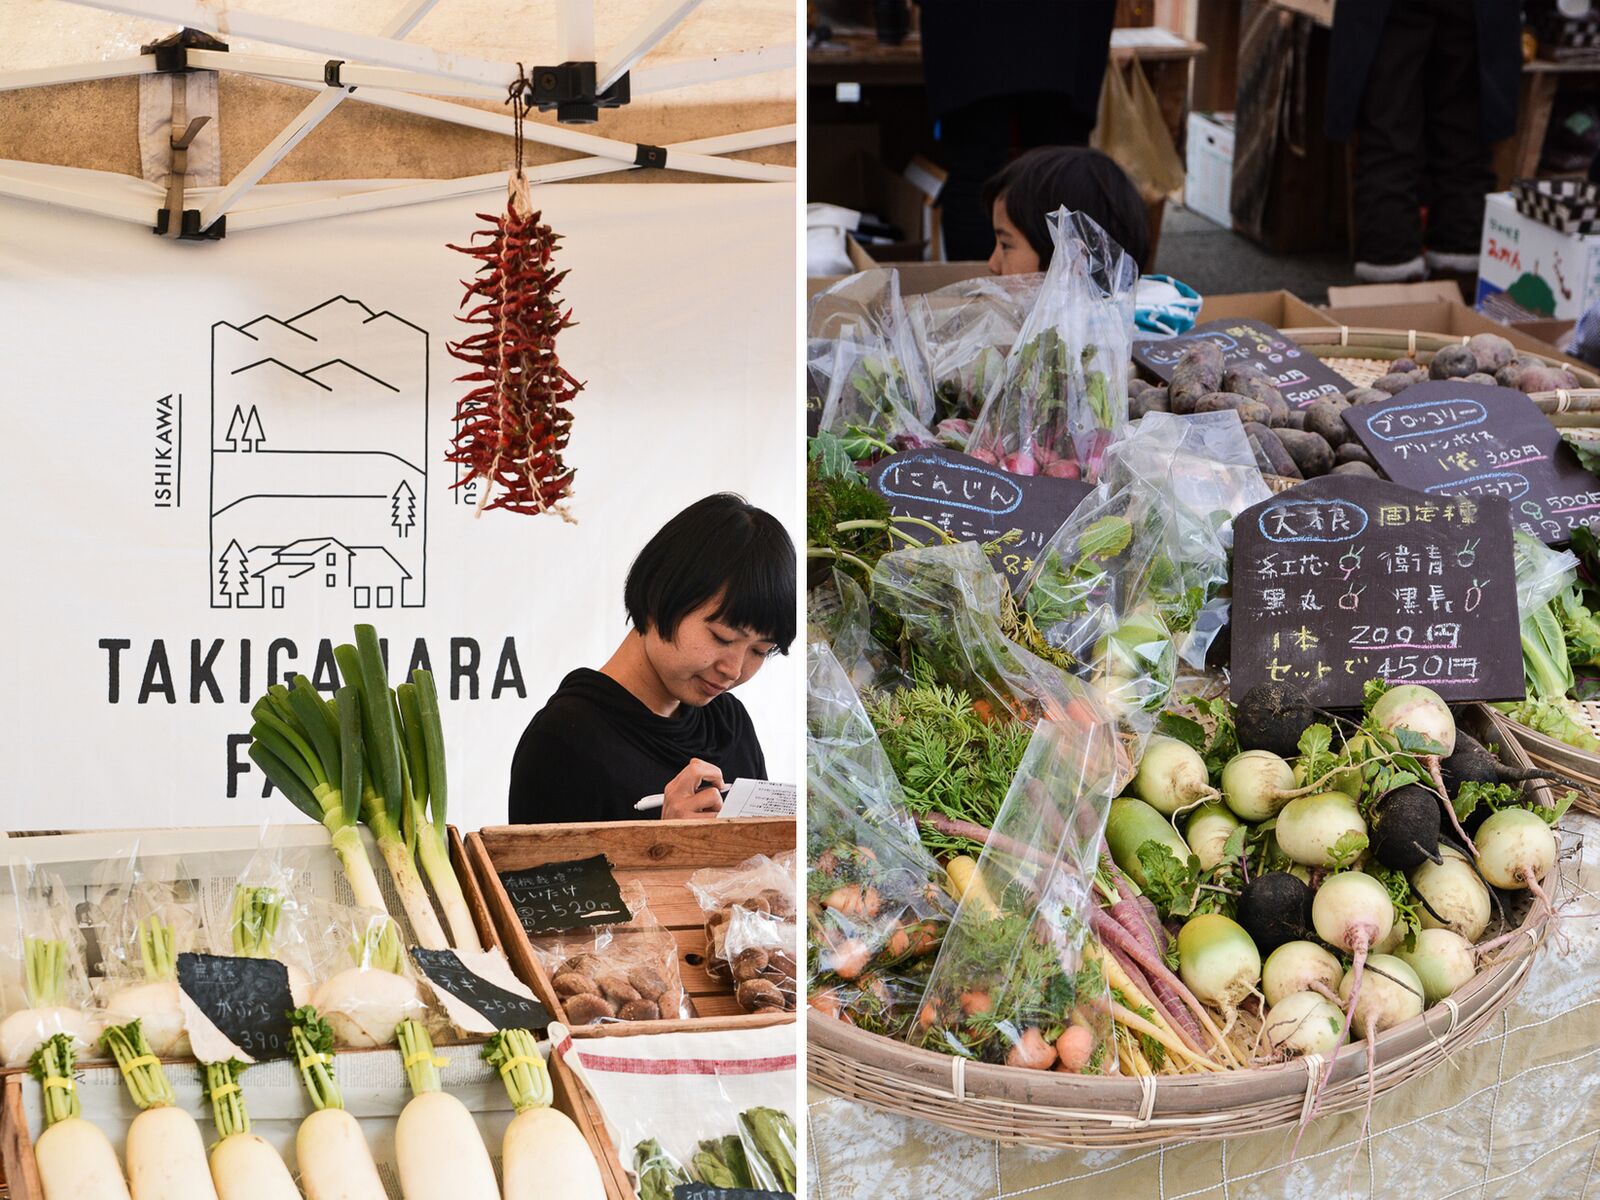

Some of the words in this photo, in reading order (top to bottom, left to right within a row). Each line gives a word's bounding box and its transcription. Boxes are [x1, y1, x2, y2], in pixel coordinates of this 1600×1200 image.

[1375, 407, 1478, 433] ブロッコリー
[154, 393, 173, 507] ISHIKAWA
[1486, 443, 1543, 465] 300円
[894, 467, 1015, 504] にんじん
[1379, 501, 1478, 529] 固定種
[1349, 623, 1461, 648] 200円
[1265, 656, 1369, 682] セットで
[1376, 655, 1480, 679] 450円
[511, 884, 577, 903] しいたけ
[551, 900, 611, 917] 520円
[439, 974, 478, 996] ネギ
[479, 999, 532, 1015] 250円
[240, 1030, 280, 1050] 390
